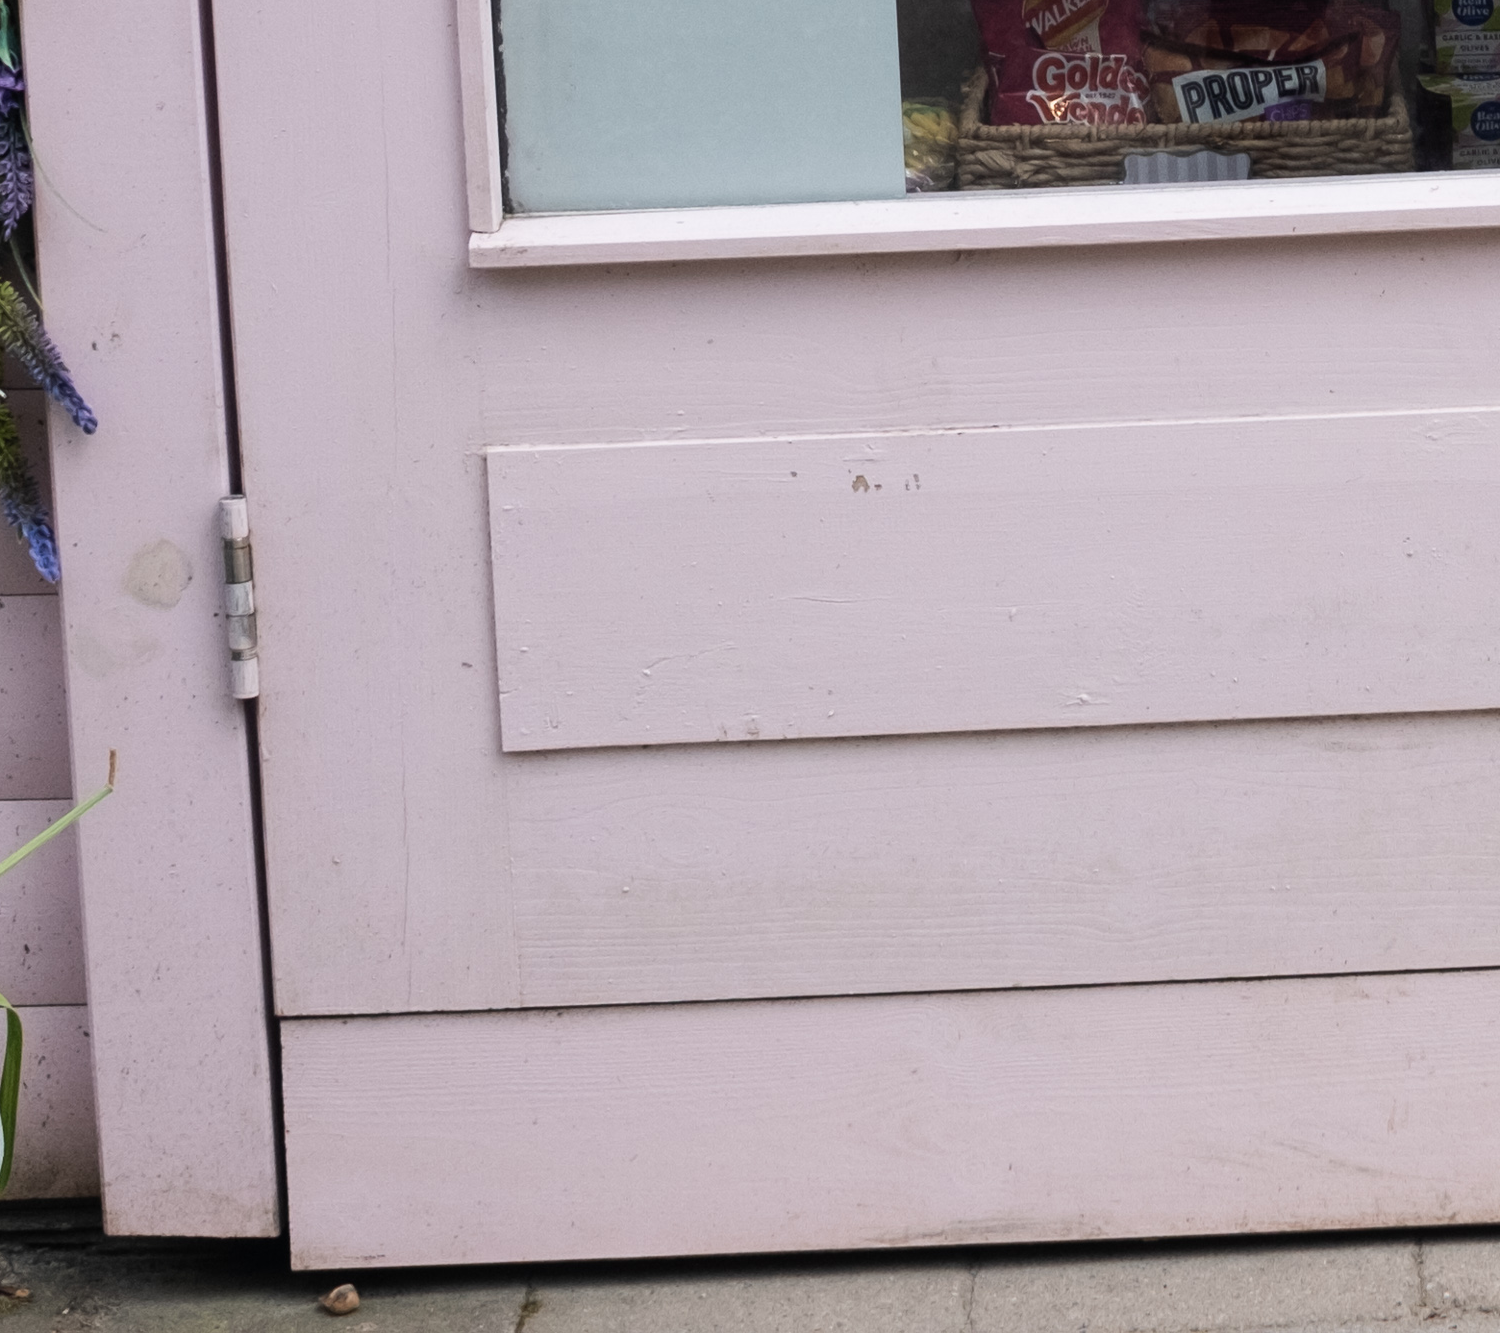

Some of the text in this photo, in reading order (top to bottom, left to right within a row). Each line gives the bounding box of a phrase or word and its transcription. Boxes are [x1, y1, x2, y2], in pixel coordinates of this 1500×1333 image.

[1457, 5, 1490, 16] Olive
[1442, 34, 1473, 42] GARLIC
[1460, 44, 1490, 52] OLIVES
[1181, 65, 1319, 123] PROPER
[1270, 104, 1308, 122] CHIPS
